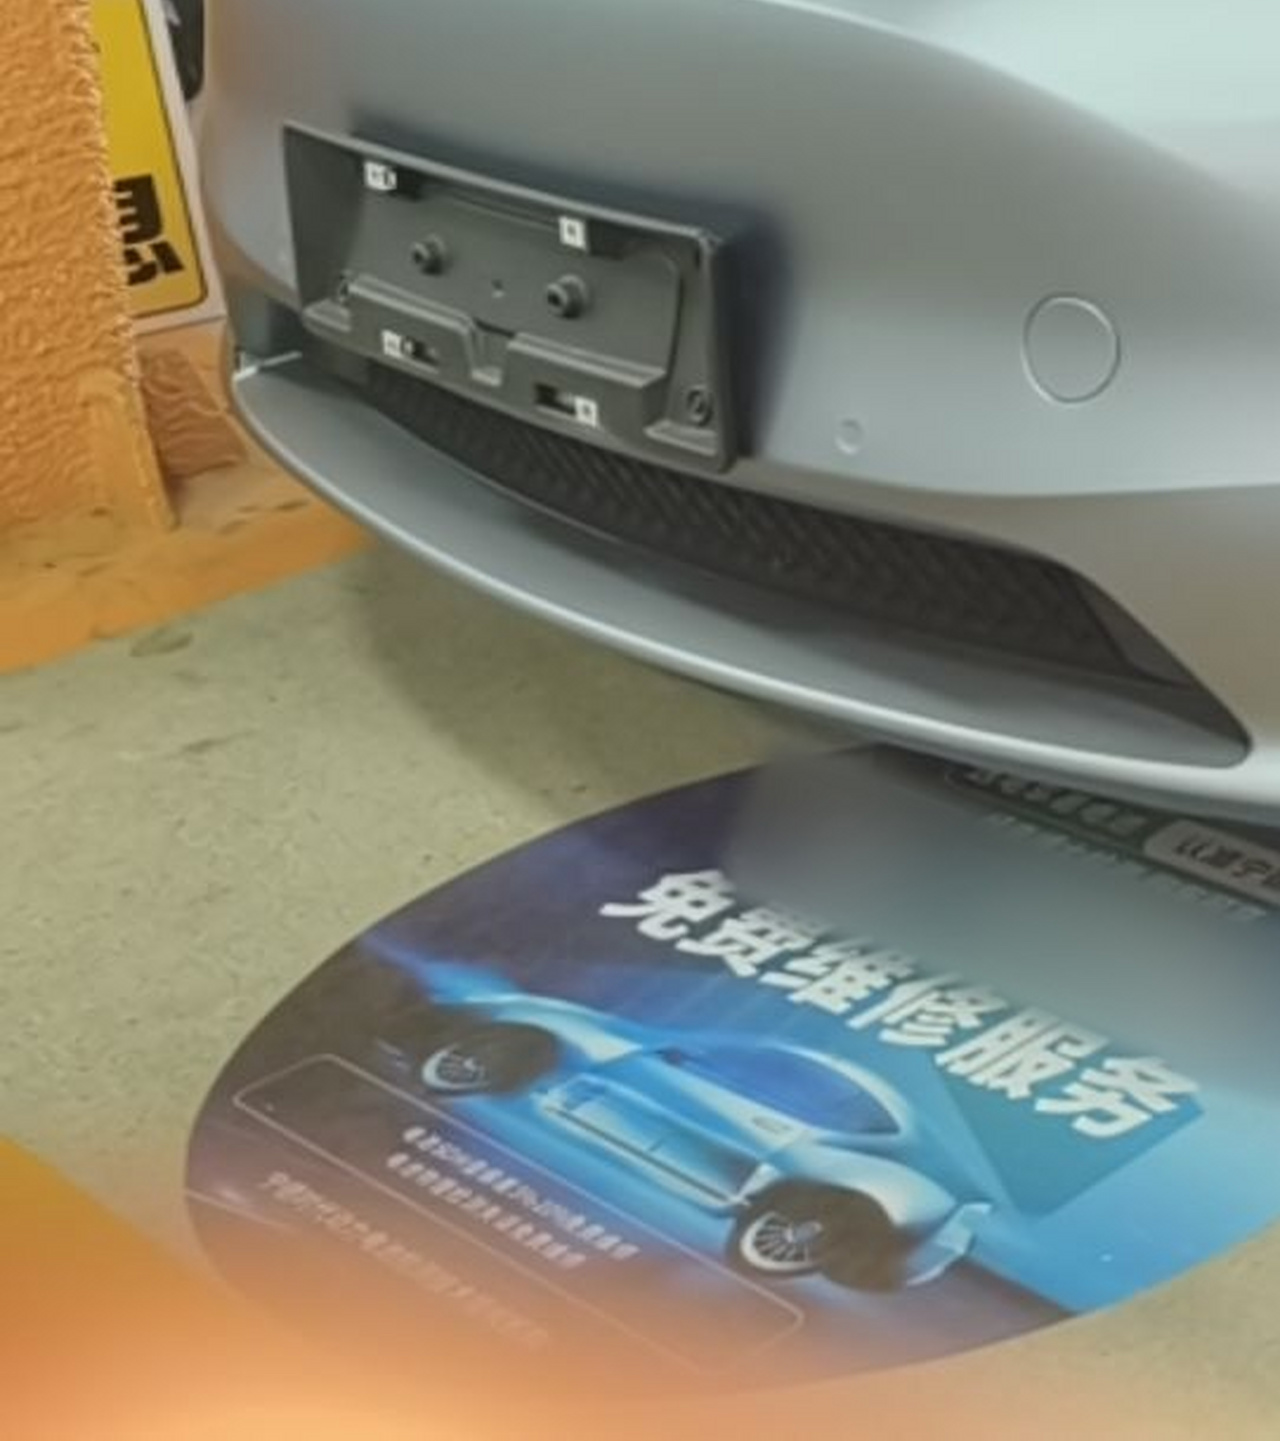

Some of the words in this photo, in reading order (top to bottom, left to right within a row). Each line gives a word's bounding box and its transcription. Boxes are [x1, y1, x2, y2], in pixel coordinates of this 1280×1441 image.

[600, 868, 1199, 1139] 免费维修服务
